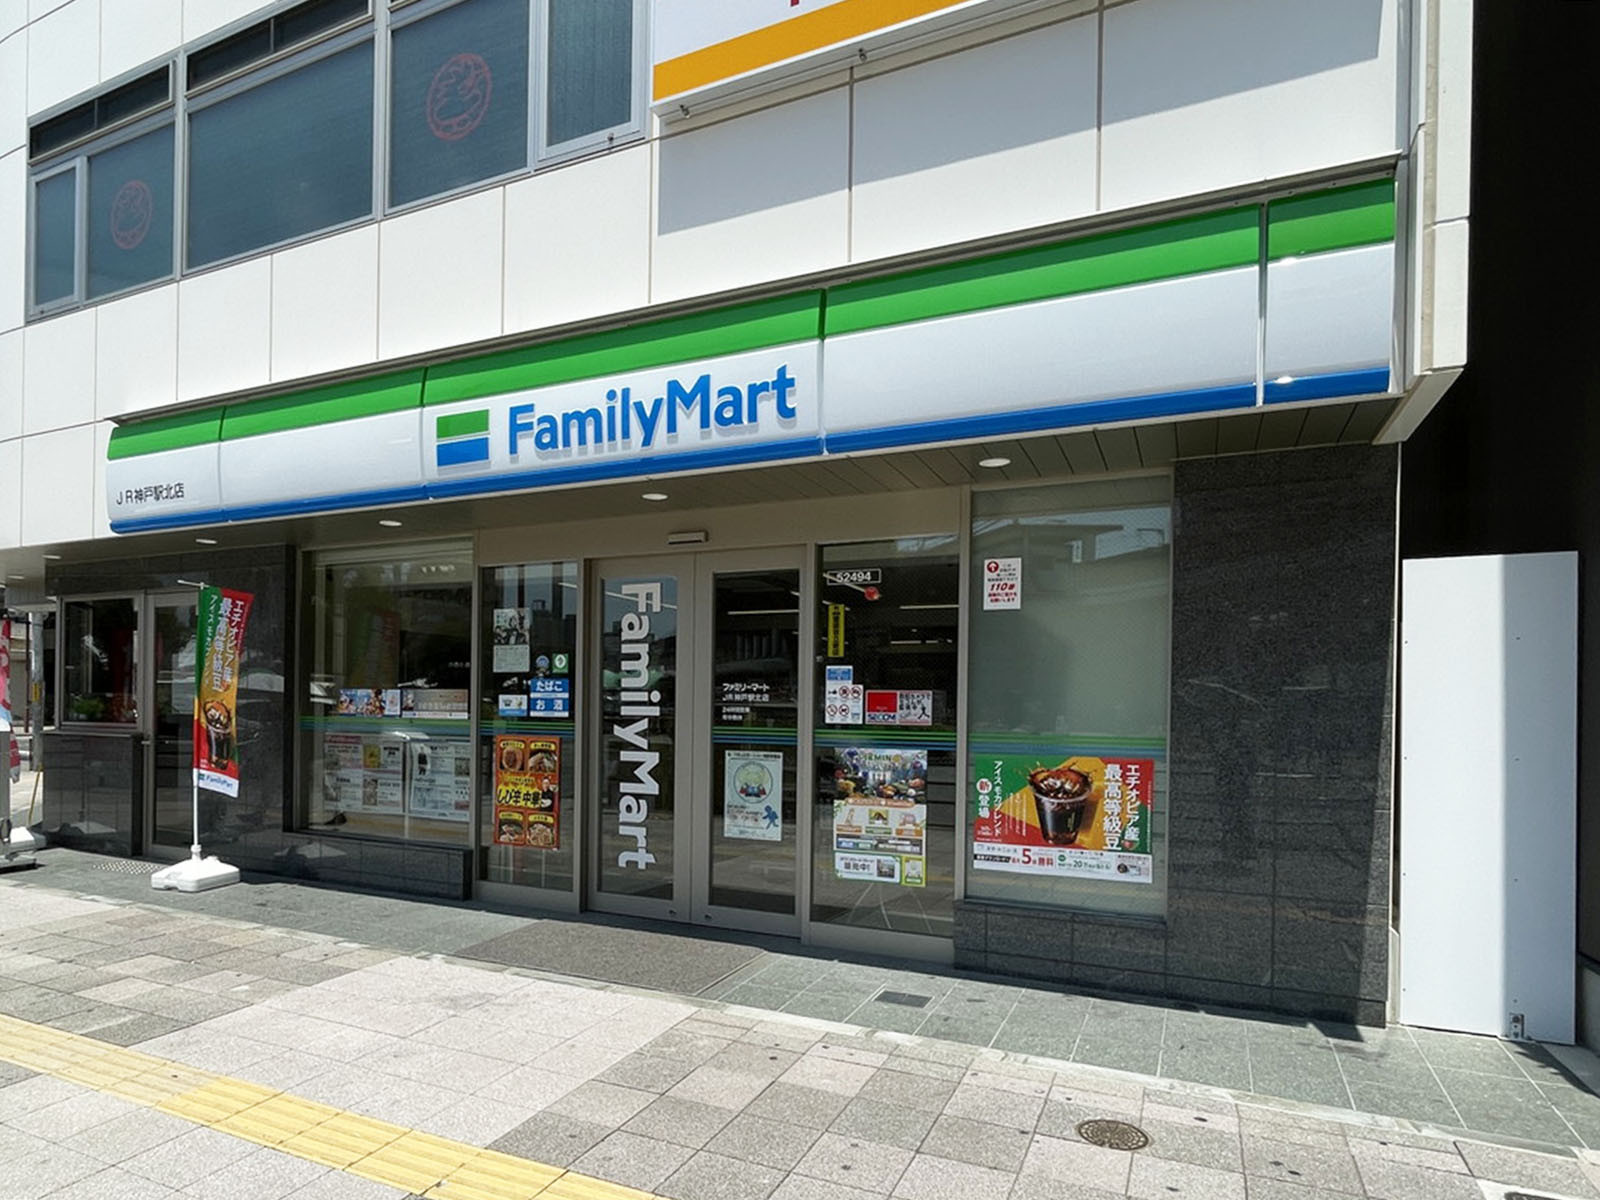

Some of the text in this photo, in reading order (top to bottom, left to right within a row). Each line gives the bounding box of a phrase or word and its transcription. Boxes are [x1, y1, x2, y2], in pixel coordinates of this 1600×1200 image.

[509, 364, 795, 455] FamilyMart
[535, 680, 563, 692] たばこ
[613, 581, 661, 870] FamilyMart
[1103, 763, 1123, 850] 最高等級豆
[1124, 764, 1141, 841] エチオピア産
